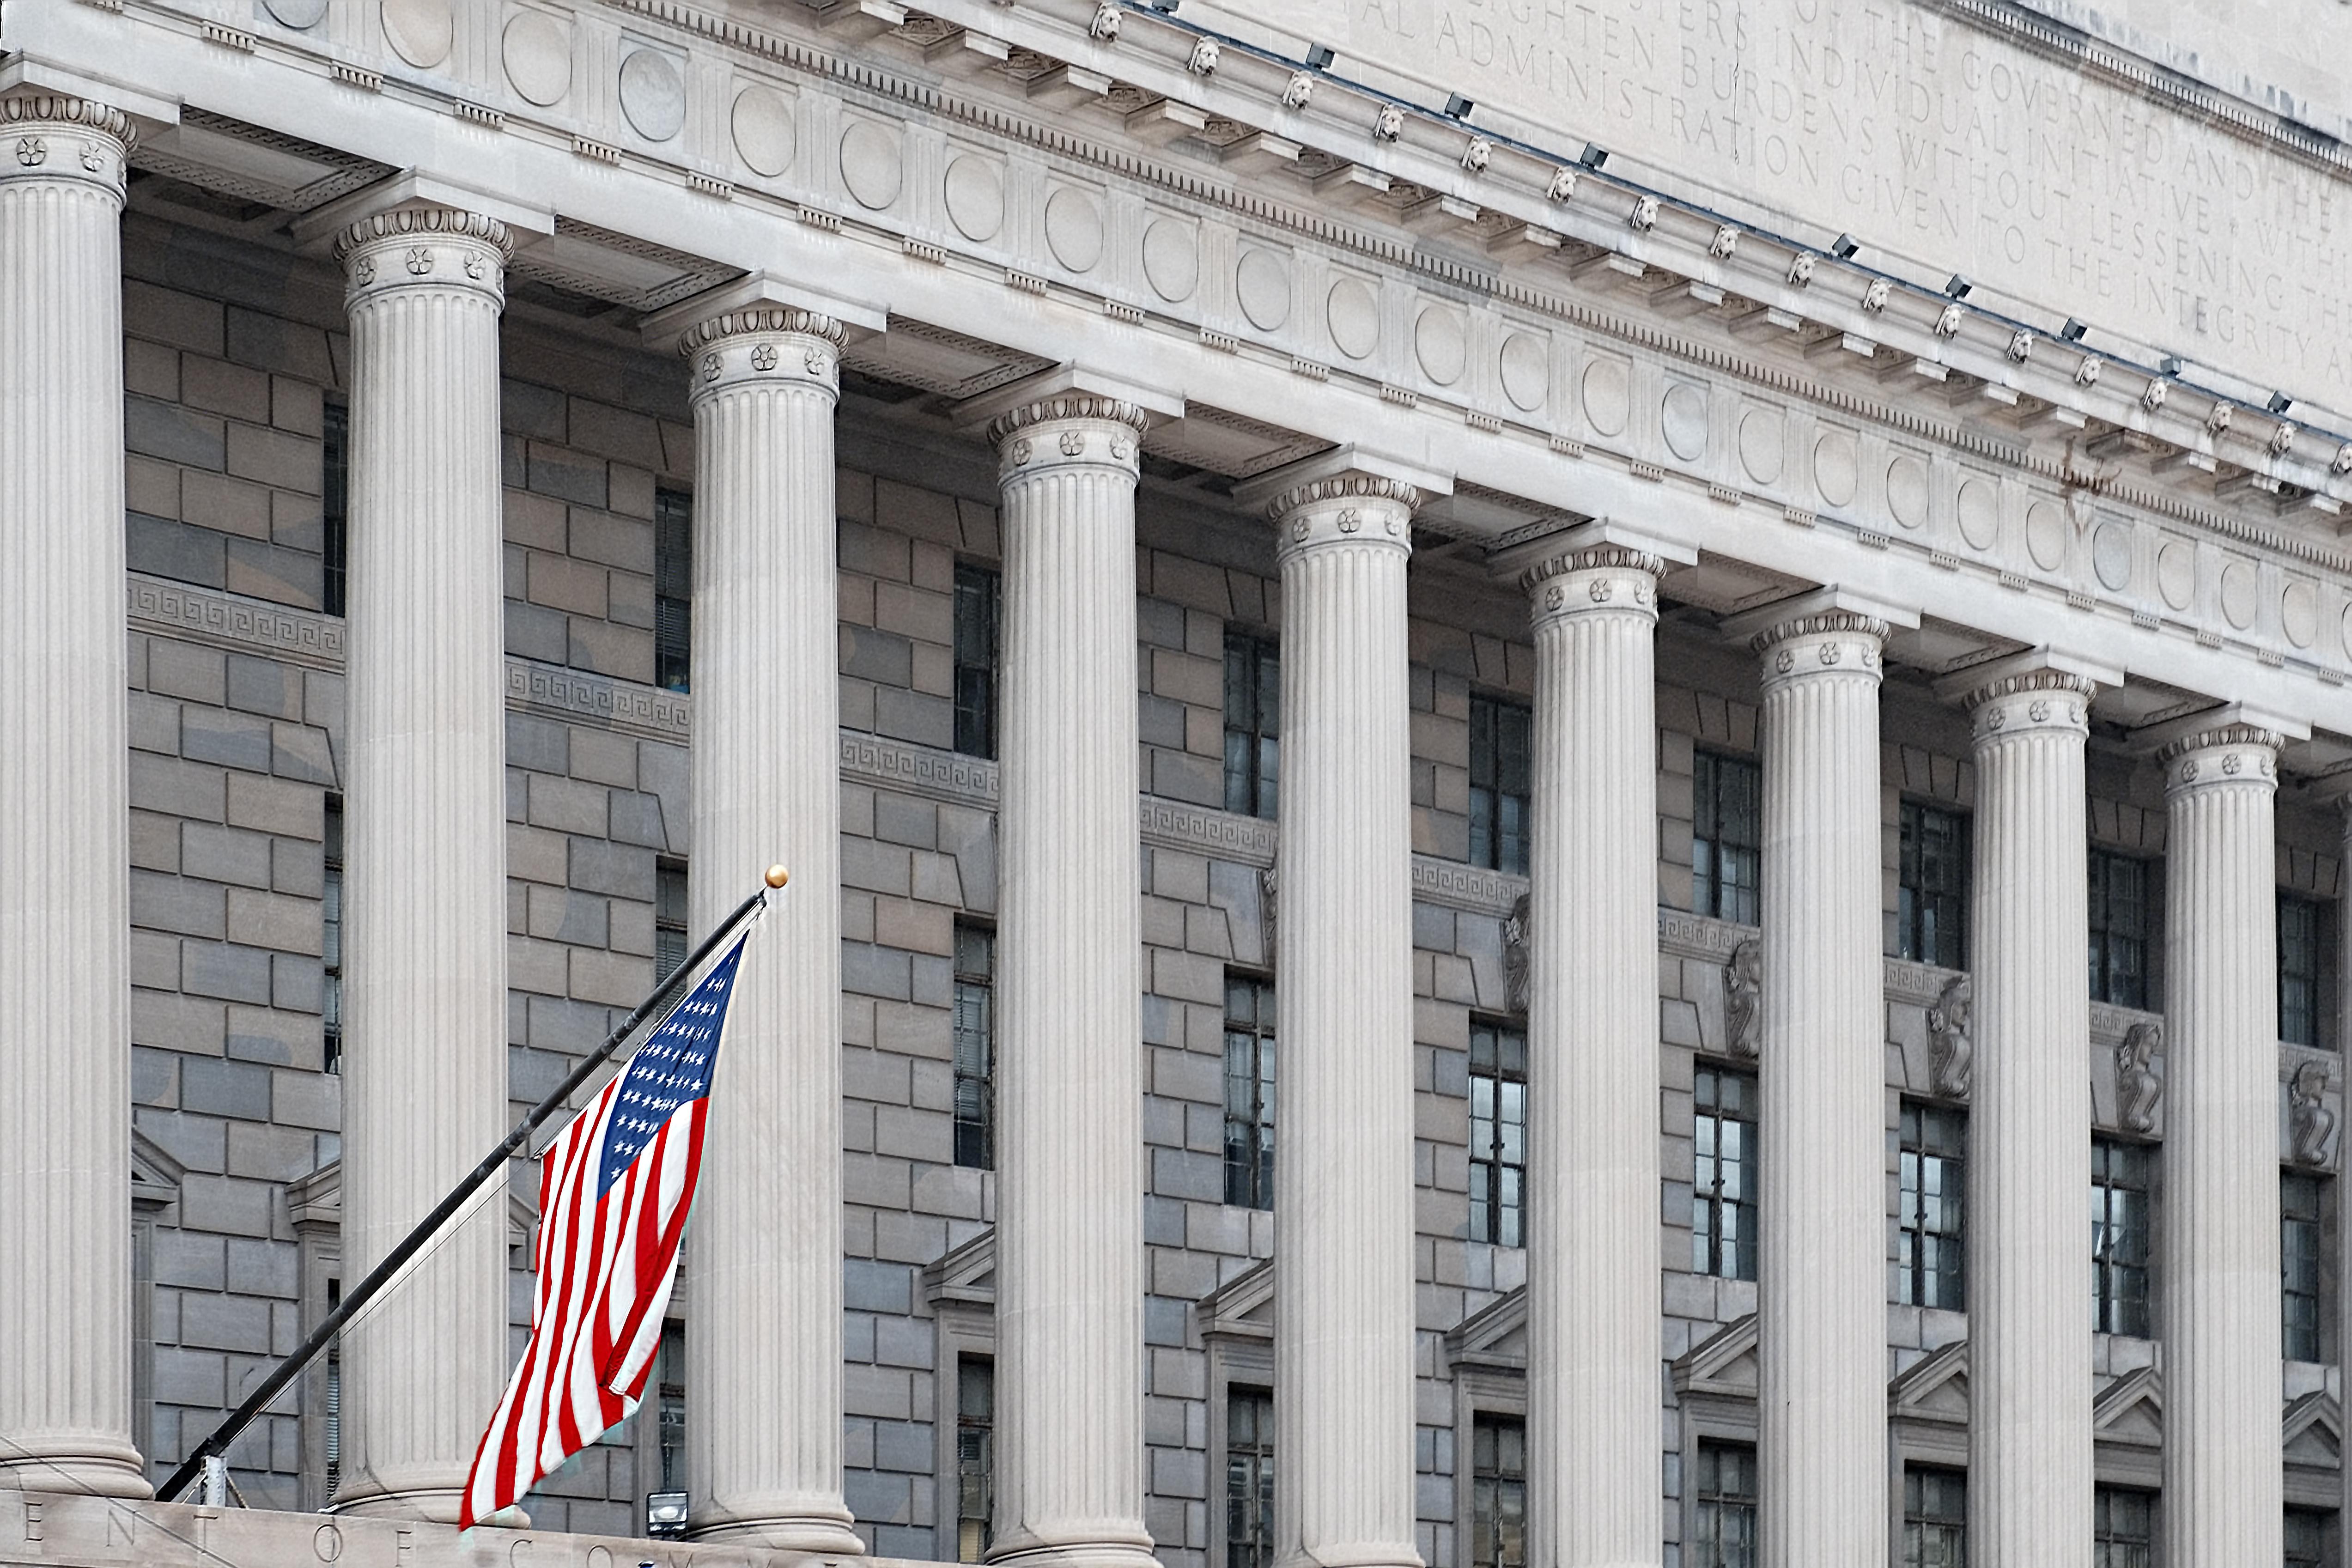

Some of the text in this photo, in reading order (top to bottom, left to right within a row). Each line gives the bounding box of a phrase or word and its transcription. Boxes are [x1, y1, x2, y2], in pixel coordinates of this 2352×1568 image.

[1435, 12, 1819, 186] ADMINISTRATION
[1841, 164, 1959, 239] GIVEN
[1981, 213, 2025, 264] TO
[2044, 237, 2111, 298] THE
[2133, 271, 2311, 370] INTEGRITY
[1681, 45, 1873, 156] BURDENS
[1896, 128, 2071, 231] WITHOUT
[2091, 204, 2282, 311] LESSENING
[1775, 26, 2008, 156] INDIVIDUAL
[1865, 8, 1937, 74] THE
[1962, 50, 2163, 164] GOVERNED
[2181, 142, 2253, 201] AND
[2271, 175, 2331, 233] THE
[313, 1524, 413, 1568] OF
